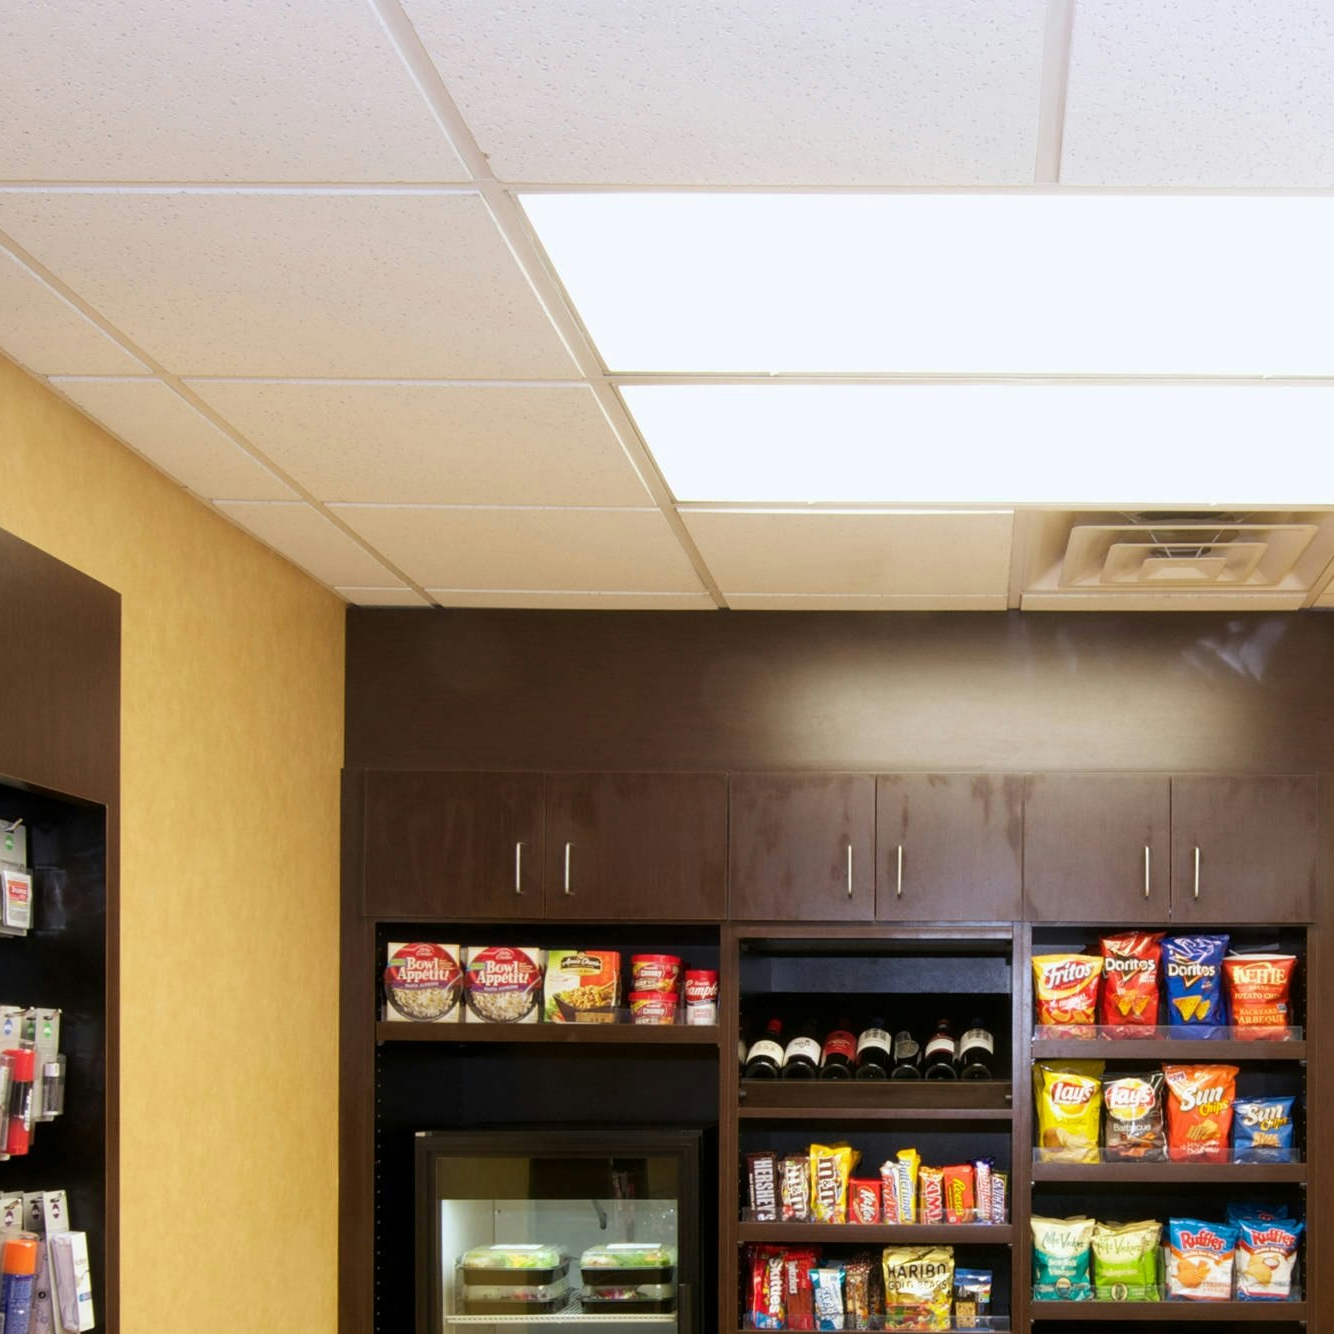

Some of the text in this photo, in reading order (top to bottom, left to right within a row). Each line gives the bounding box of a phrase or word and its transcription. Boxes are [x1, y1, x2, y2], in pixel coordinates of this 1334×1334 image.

[406, 957, 439, 970] Bowl
[486, 960, 518, 974] Bowl
[1105, 957, 1155, 972] Doritos
[1168, 964, 1216, 977] Doritos
[1044, 960, 1092, 988] Fritos
[1181, 1086, 1224, 1112] Sun
[1199, 1100, 1230, 1117] Chips
[1243, 1104, 1283, 1128] Sun
[754, 1157, 776, 1221] HERSHEY'S
[1181, 1231, 1225, 1251] Ruffles
[1252, 1229, 1296, 1248] Ruffles
[888, 1263, 947, 1279] HARIBO
[769, 1258, 783, 1313] Skittles
